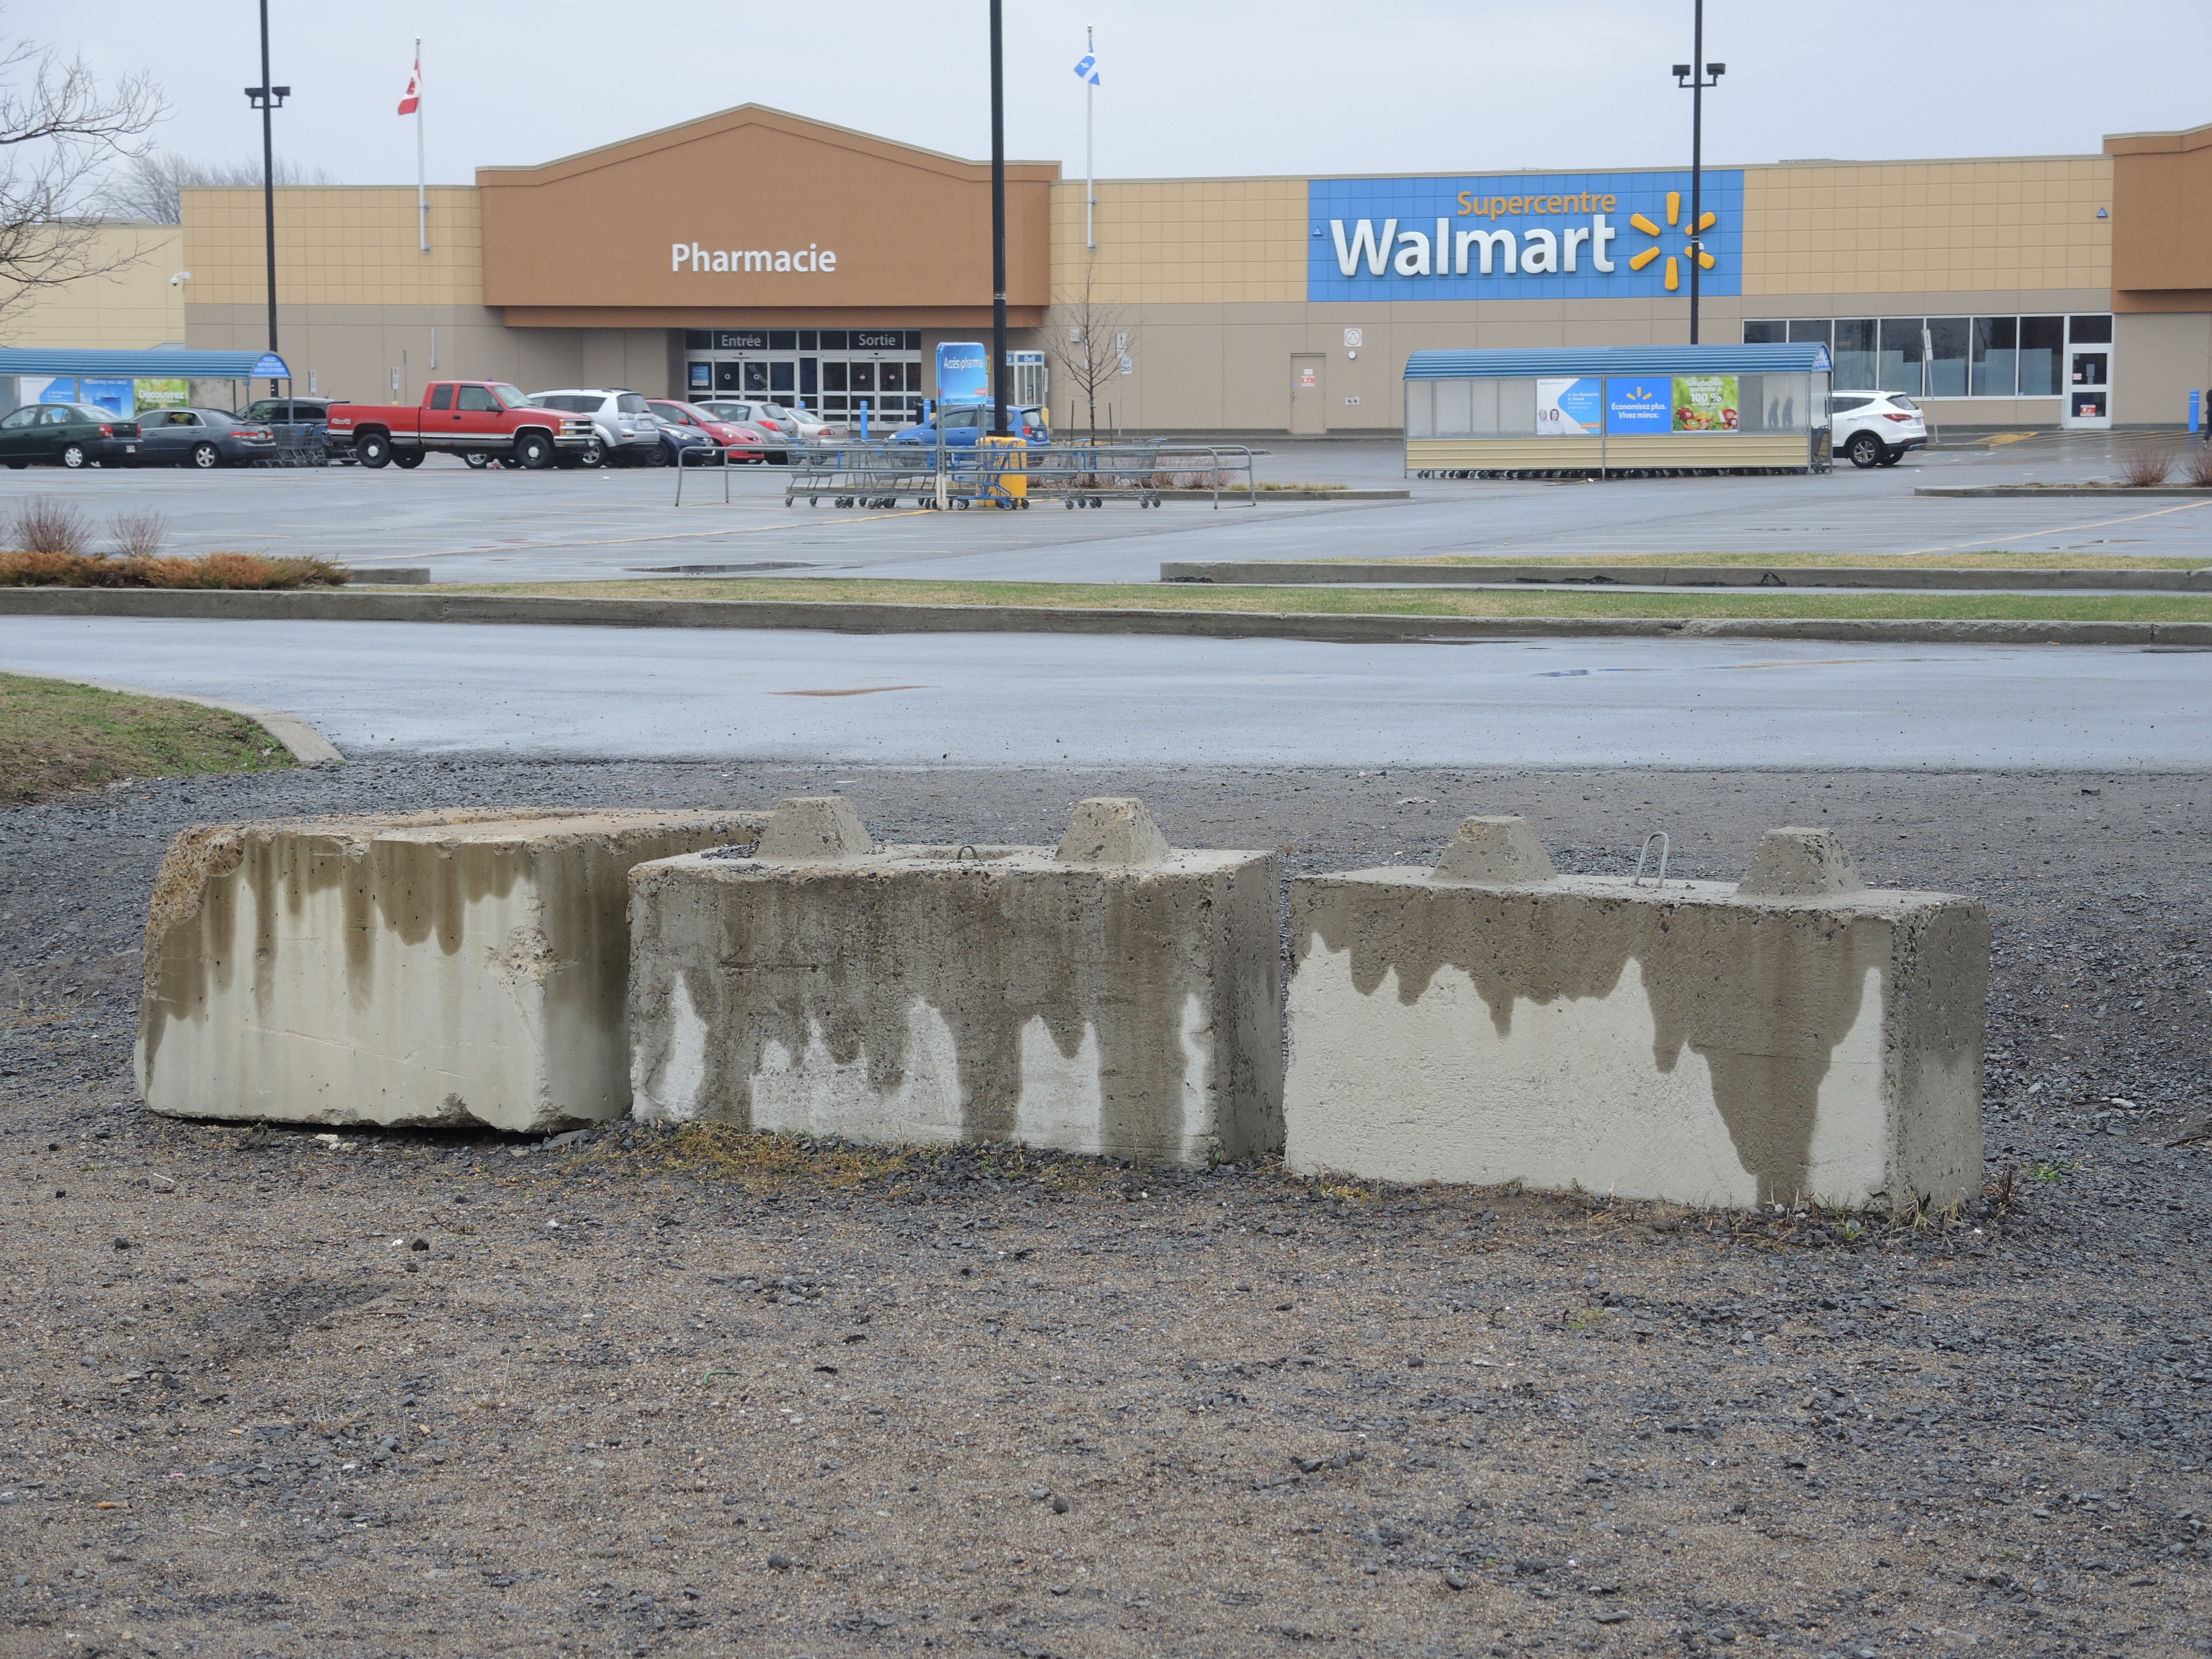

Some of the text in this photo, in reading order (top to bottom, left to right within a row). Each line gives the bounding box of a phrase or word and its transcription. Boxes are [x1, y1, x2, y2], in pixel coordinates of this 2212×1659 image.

[1457, 191, 1616, 221] Supercentre
[1329, 214, 1615, 276] Walmart
[672, 242, 837, 272] Pharmacie
[722, 335, 761, 346] Entrée
[859, 334, 895, 346] Sortie
[139, 389, 185, 399] Découvrez
[1690, 393, 1721, 402] 100 %
[1651, 403, 1667, 411] plus.
